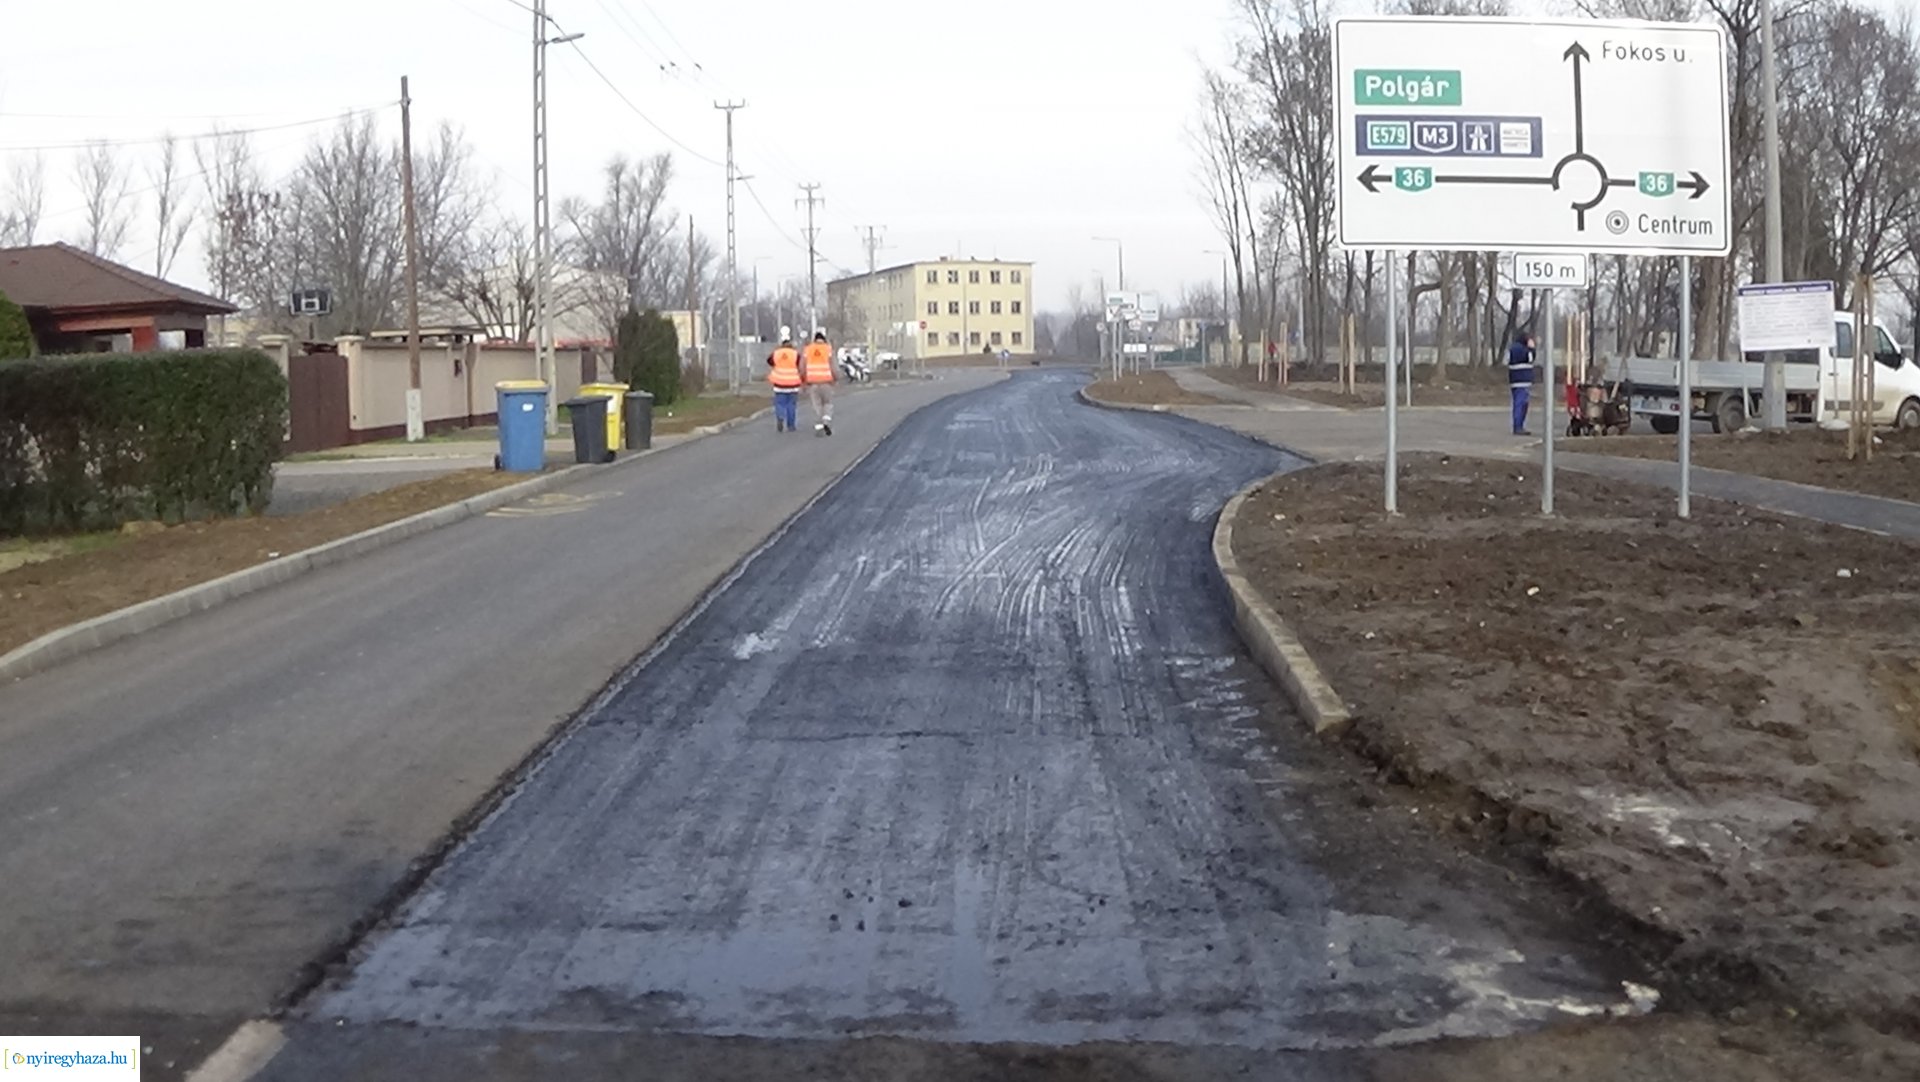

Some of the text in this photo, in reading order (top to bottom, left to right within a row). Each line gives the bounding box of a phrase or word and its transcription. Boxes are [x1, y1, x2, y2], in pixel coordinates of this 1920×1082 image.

[1602, 40, 1693, 63] Fokos u.
[1365, 75, 1450, 102] Polgár
[1372, 126, 1406, 144] E579
[1422, 127, 1449, 144] M3
[1402, 169, 1426, 187] 36
[1646, 174, 1668, 192] 36
[1638, 213, 1713, 235] Centrum
[1526, 262, 1576, 278] 150 m
